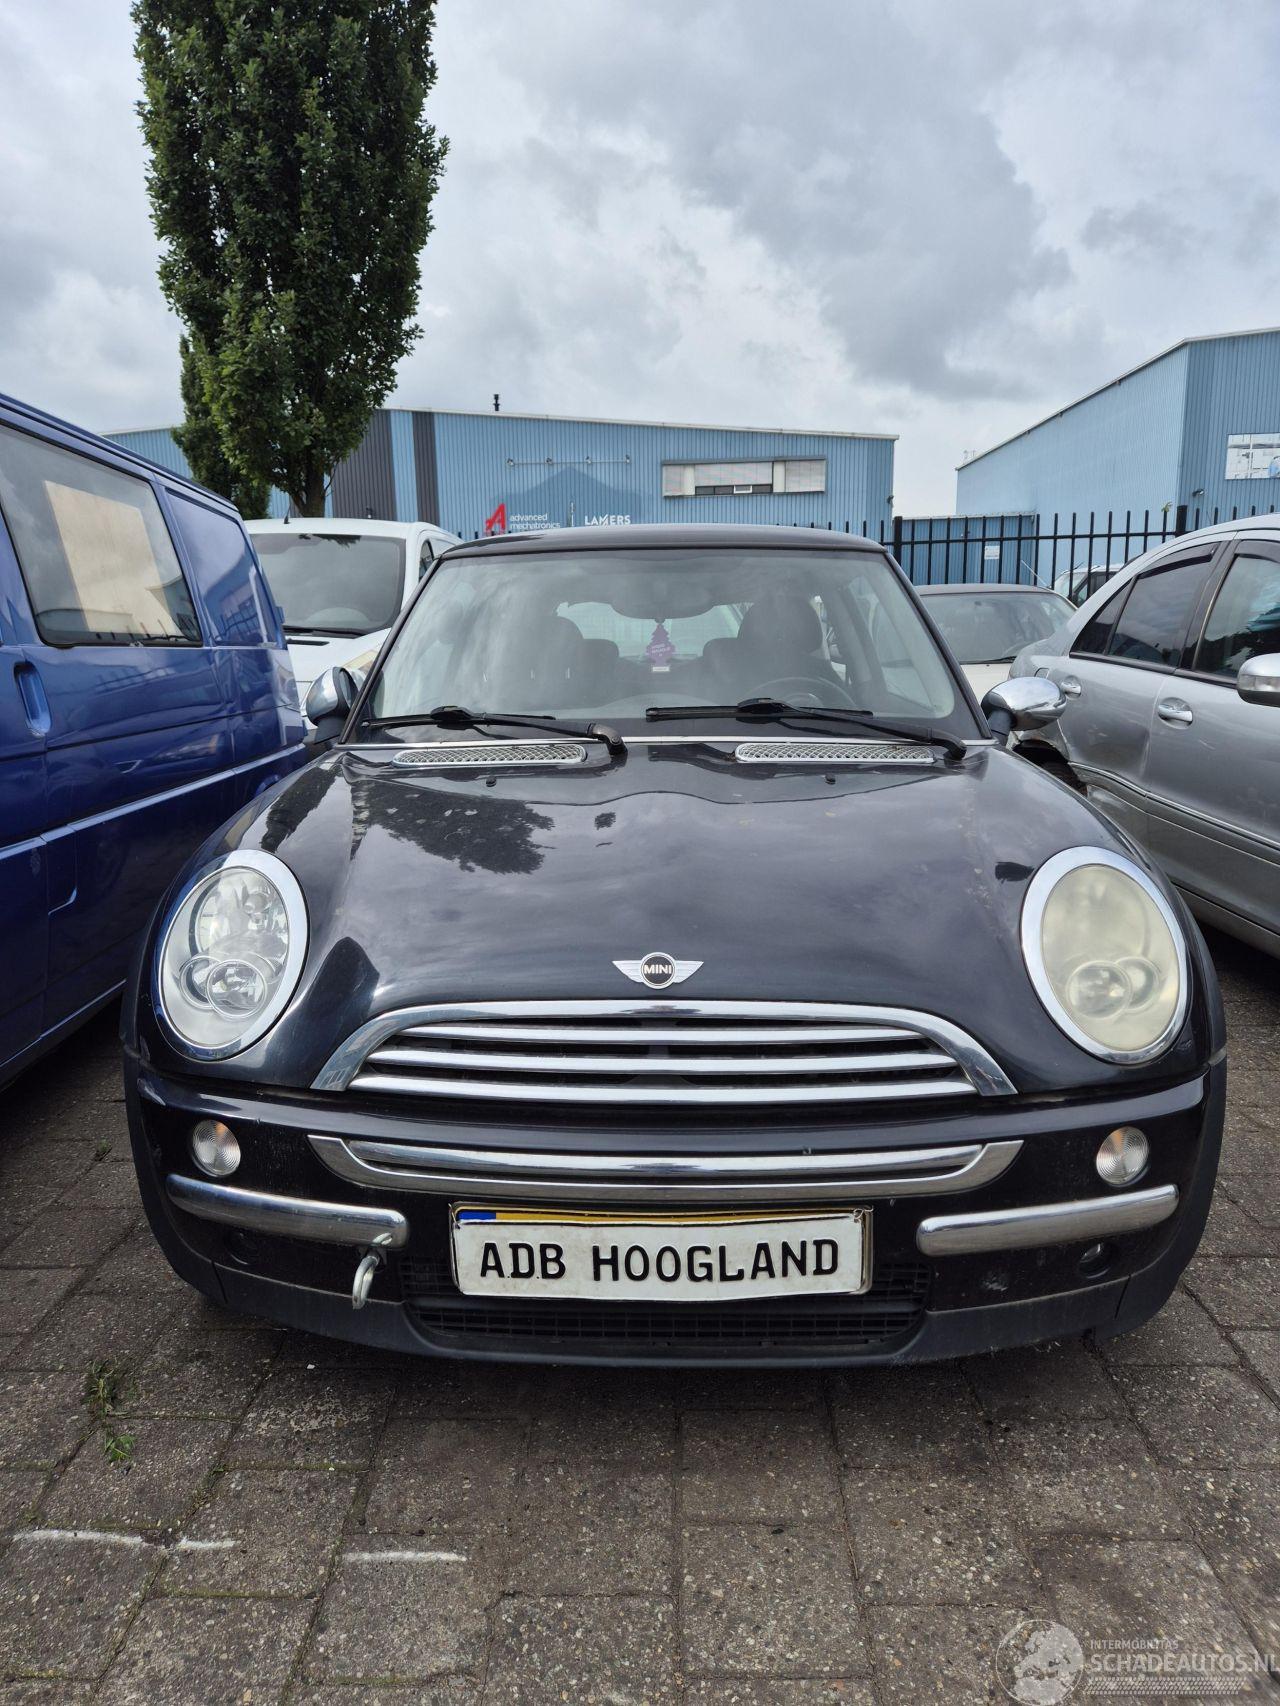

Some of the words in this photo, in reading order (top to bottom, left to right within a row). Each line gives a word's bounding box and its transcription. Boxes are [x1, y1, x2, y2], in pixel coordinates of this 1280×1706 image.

[510, 513, 548, 521] advanced
[510, 521, 561, 530] mechatronics
[643, 964, 672, 974] MINI
[592, 1238, 839, 1283] HOOGLAND
